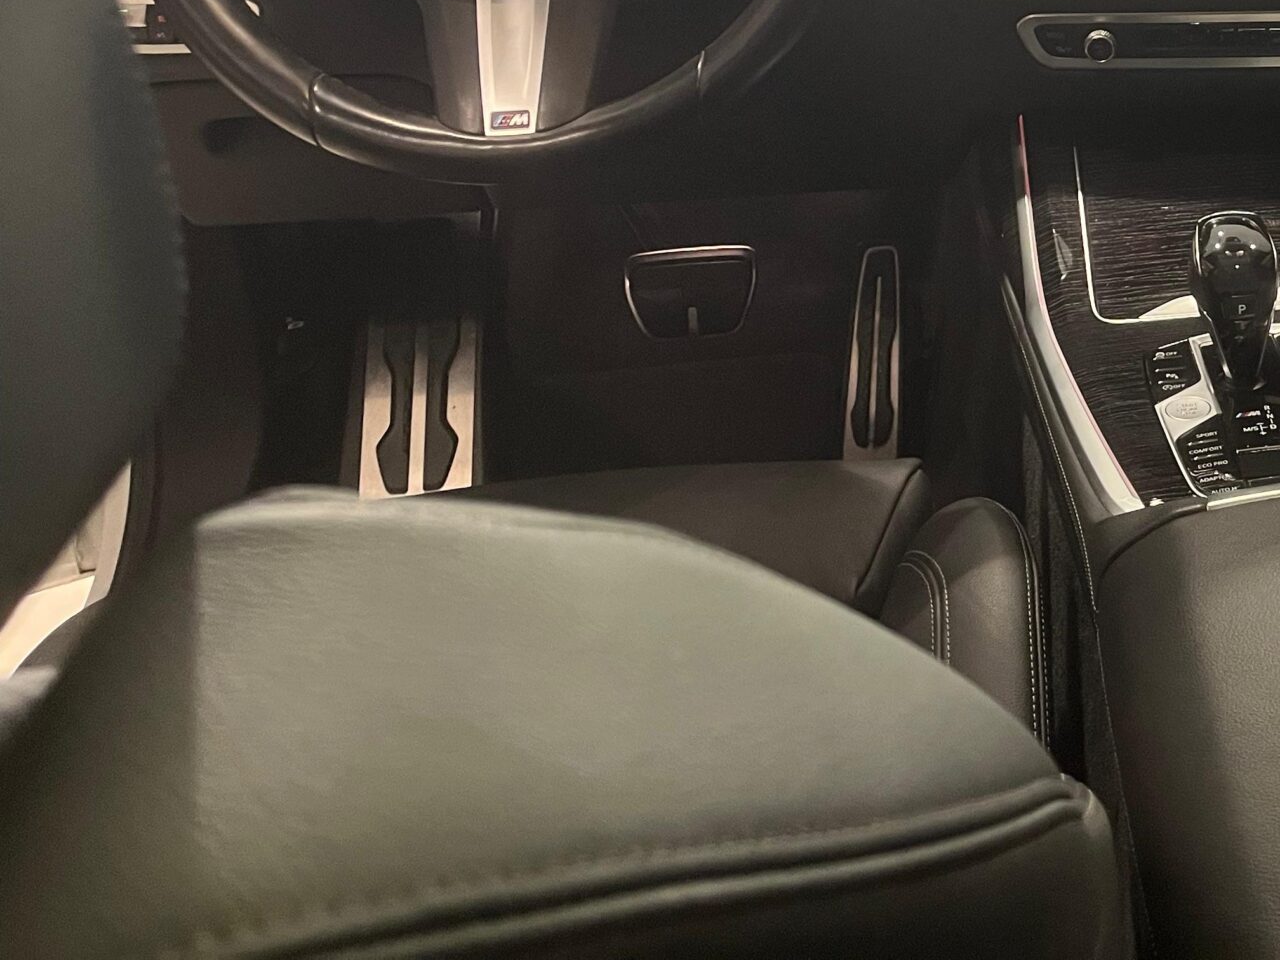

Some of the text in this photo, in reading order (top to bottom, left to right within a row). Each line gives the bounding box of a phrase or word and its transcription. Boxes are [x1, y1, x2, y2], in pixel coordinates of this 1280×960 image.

[1238, 304, 1247, 315] P
[1196, 431, 1218, 439] SPORT
[1188, 445, 1223, 455] COMFORT
